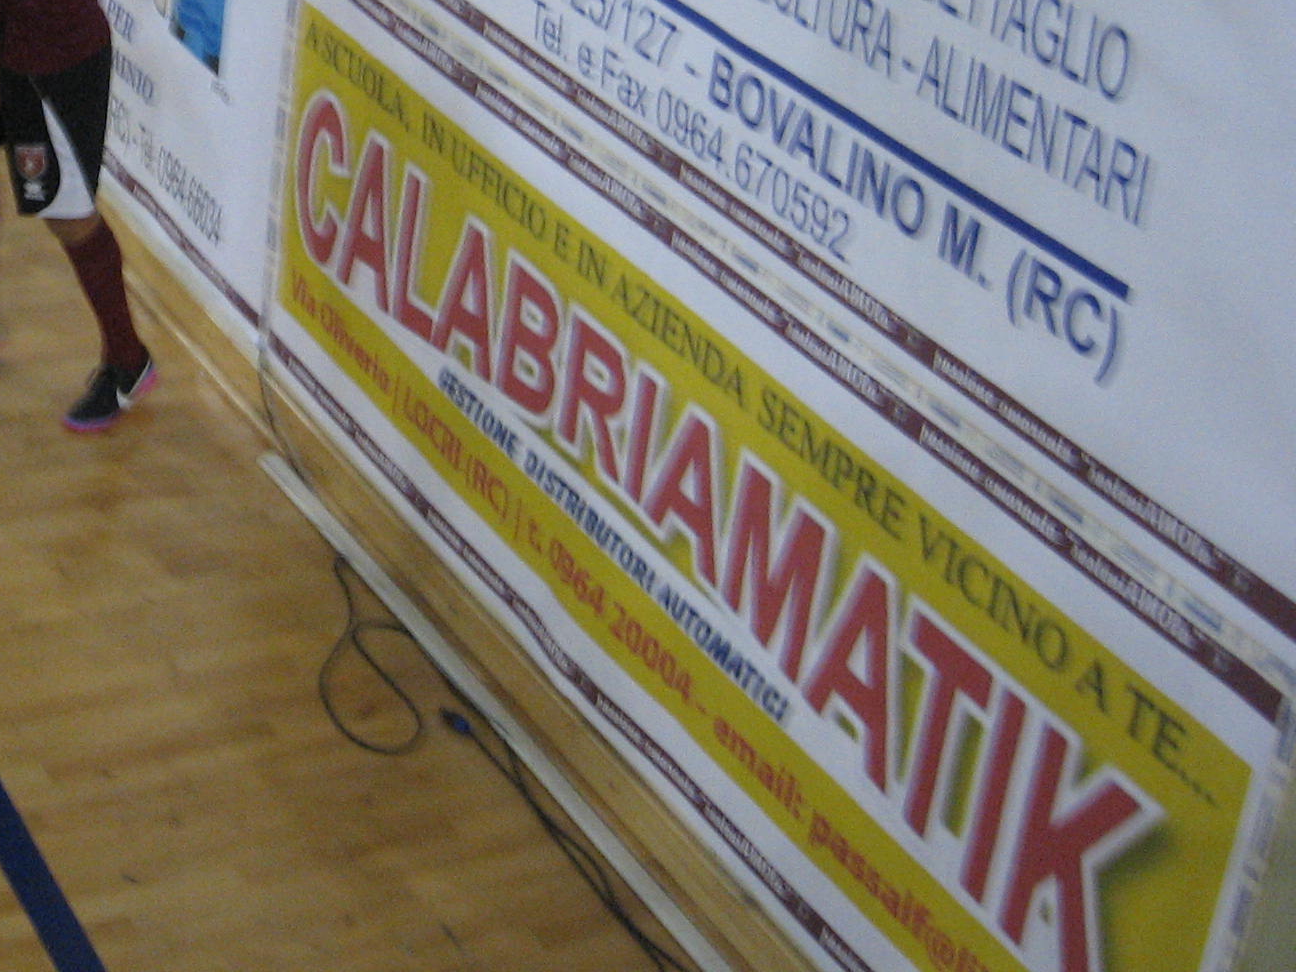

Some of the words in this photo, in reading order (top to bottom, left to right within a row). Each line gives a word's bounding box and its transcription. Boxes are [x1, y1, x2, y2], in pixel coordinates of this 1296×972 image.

[577, 41, 594, 78] e
[599, 44, 649, 119] Fax
[655, 86, 851, 264] 0964.670592
[707, 50, 926, 239] BOVALINO
[936, 200, 990, 289] M.
[1005, 247, 1119, 385] (RC)
[915, 34, 1151, 228] ALIMENTARI
[296, 94, 1148, 972] CALABRIAMATIK
[421, 110, 446, 155] IN
[451, 134, 547, 242] UFFICIO
[553, 223, 572, 263] E
[577, 239, 607, 292] IN
[611, 272, 747, 408] AZIENDA
[756, 383, 910, 540] SEMPRE
[915, 512, 1070, 674] VICINO
[1075, 659, 1110, 715] A
[438, 366, 519, 458] GESTIONE
[523, 448, 656, 599] DISTRIBUTORI
[656, 583, 789, 723] AUTOMATICI
